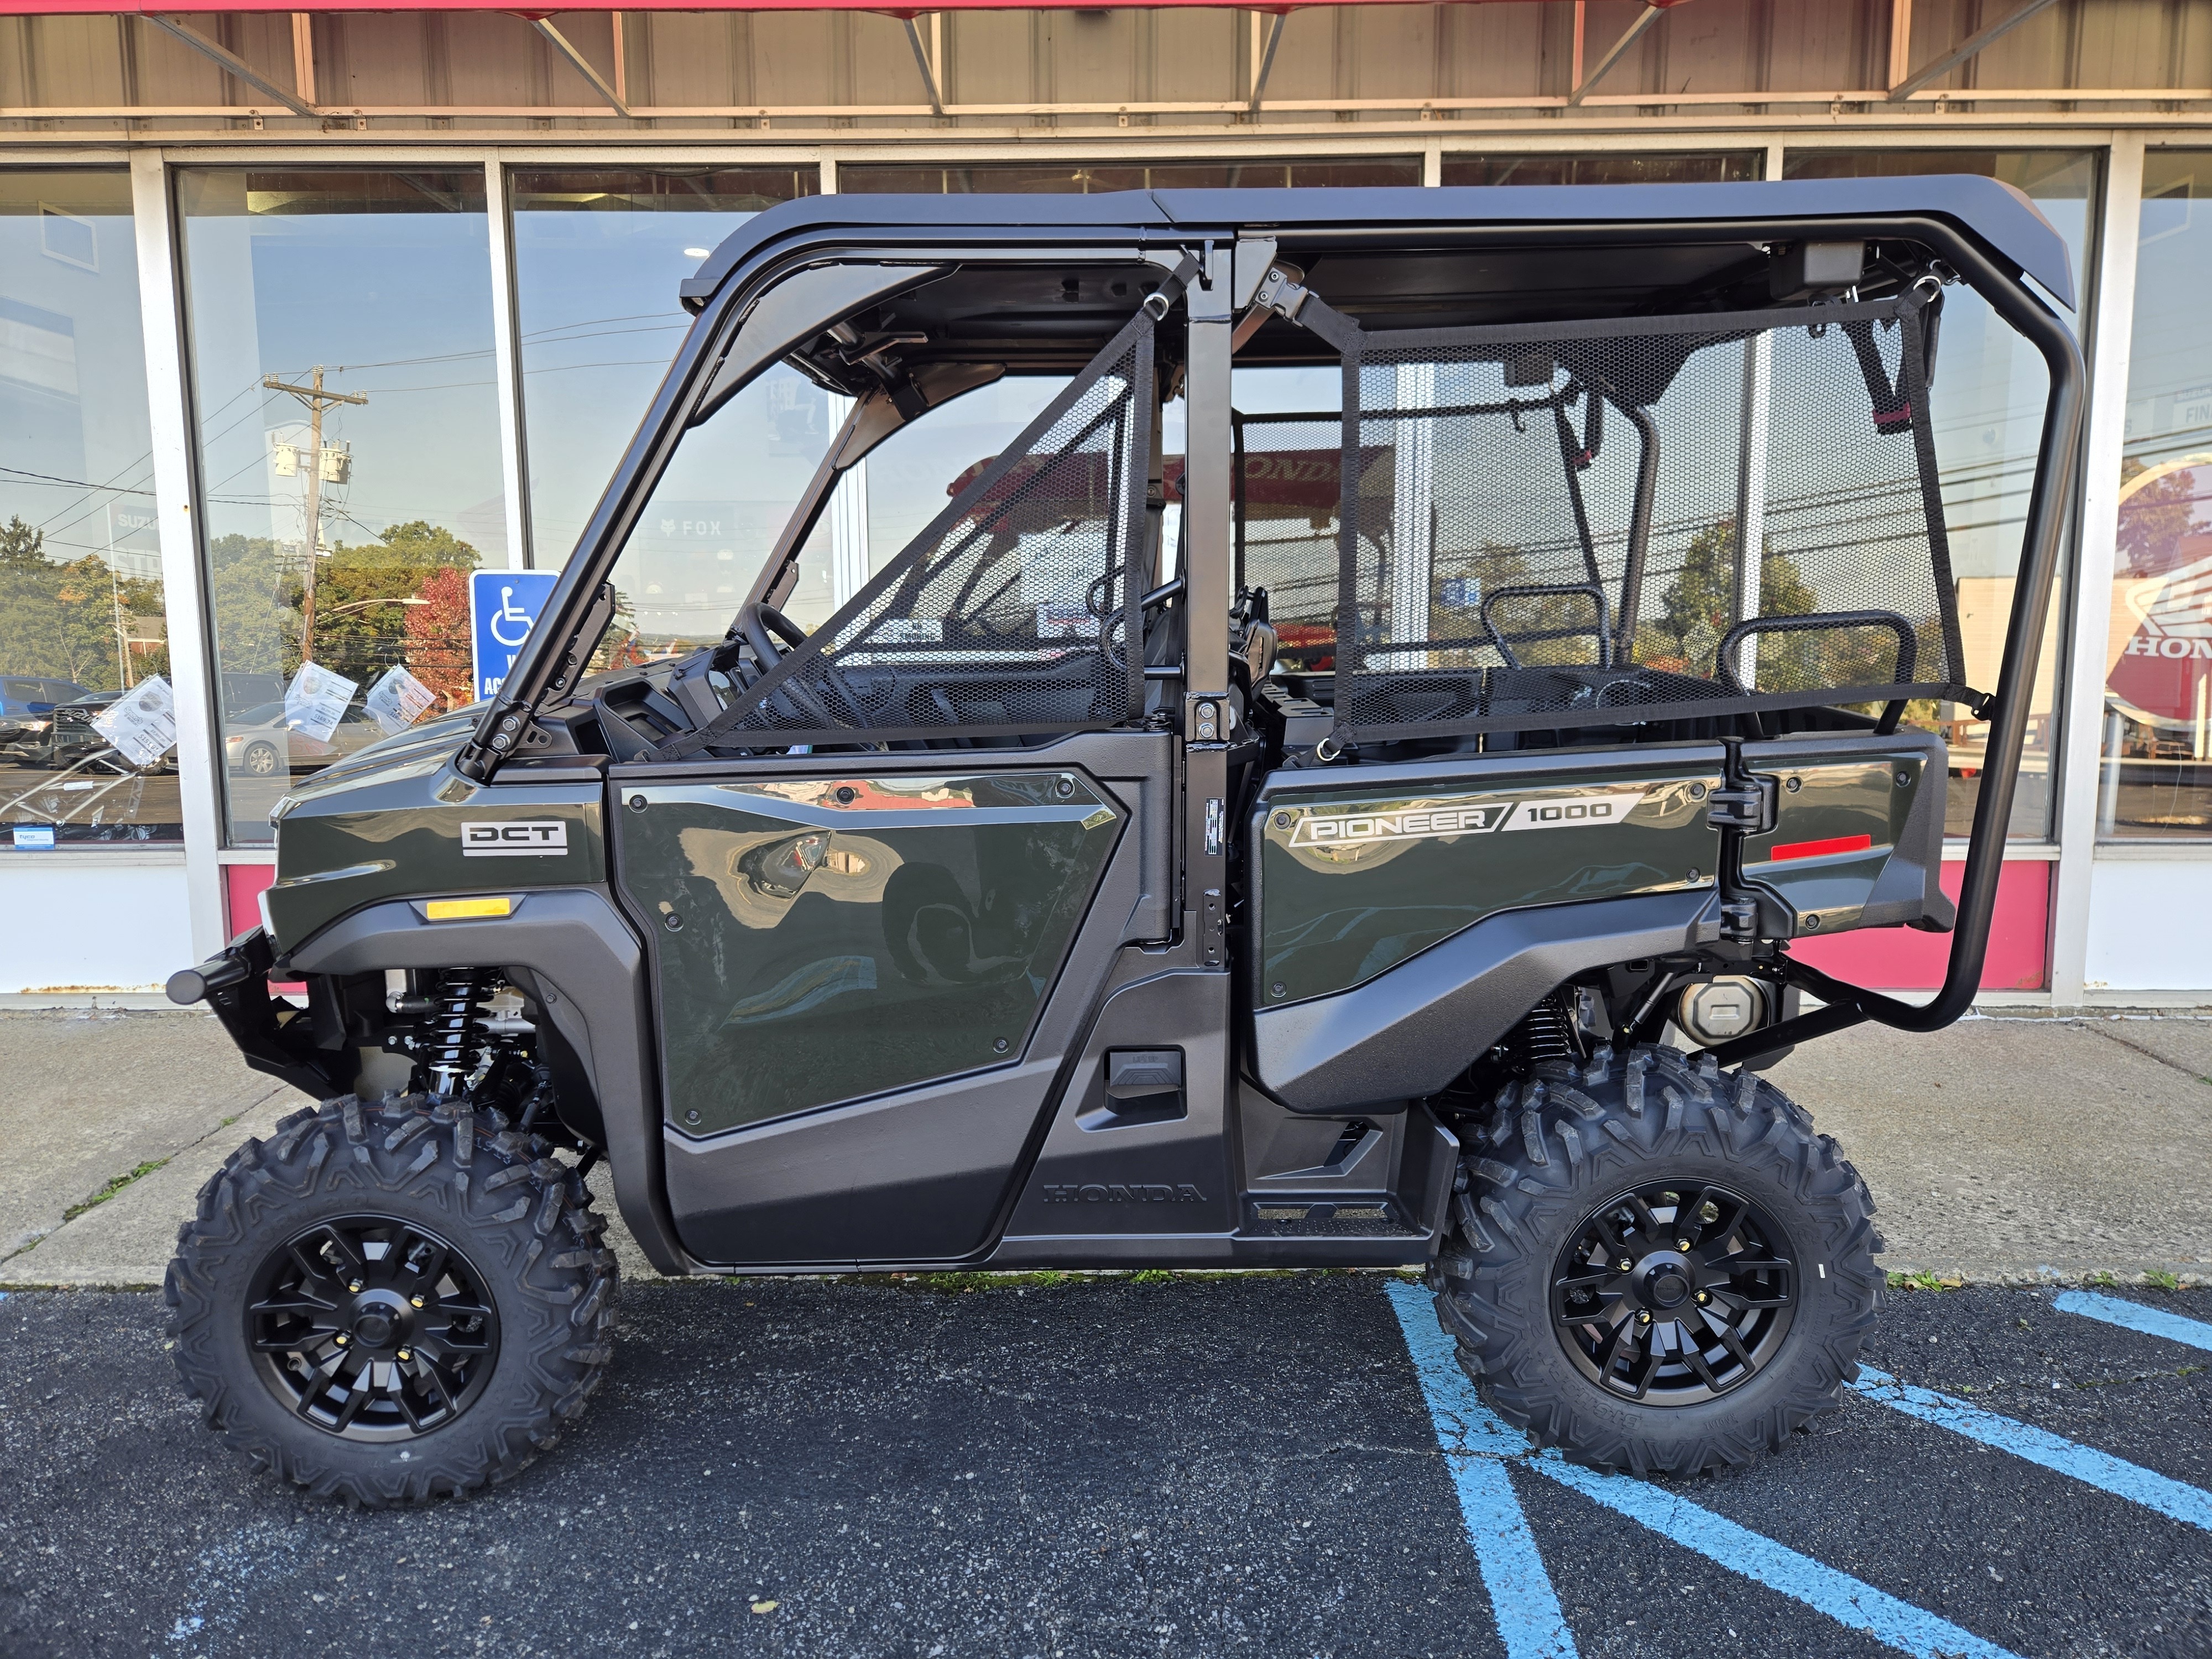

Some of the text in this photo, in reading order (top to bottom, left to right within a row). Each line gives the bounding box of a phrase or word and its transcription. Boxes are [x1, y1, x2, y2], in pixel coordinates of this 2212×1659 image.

[2186, 404, 2212, 423] FIN
[117, 513, 159, 530] SUZU
[682, 521, 721, 535] FOX
[314, 713, 333, 726] $169.74
[1311, 802, 1613, 840] PIONEER 1000
[469, 827, 559, 841] DCT
[1044, 1184, 1207, 1202] HONDA
[1537, 1349, 1644, 1431] BIGHORN
[1705, 1412, 1737, 1430] RADIAL
